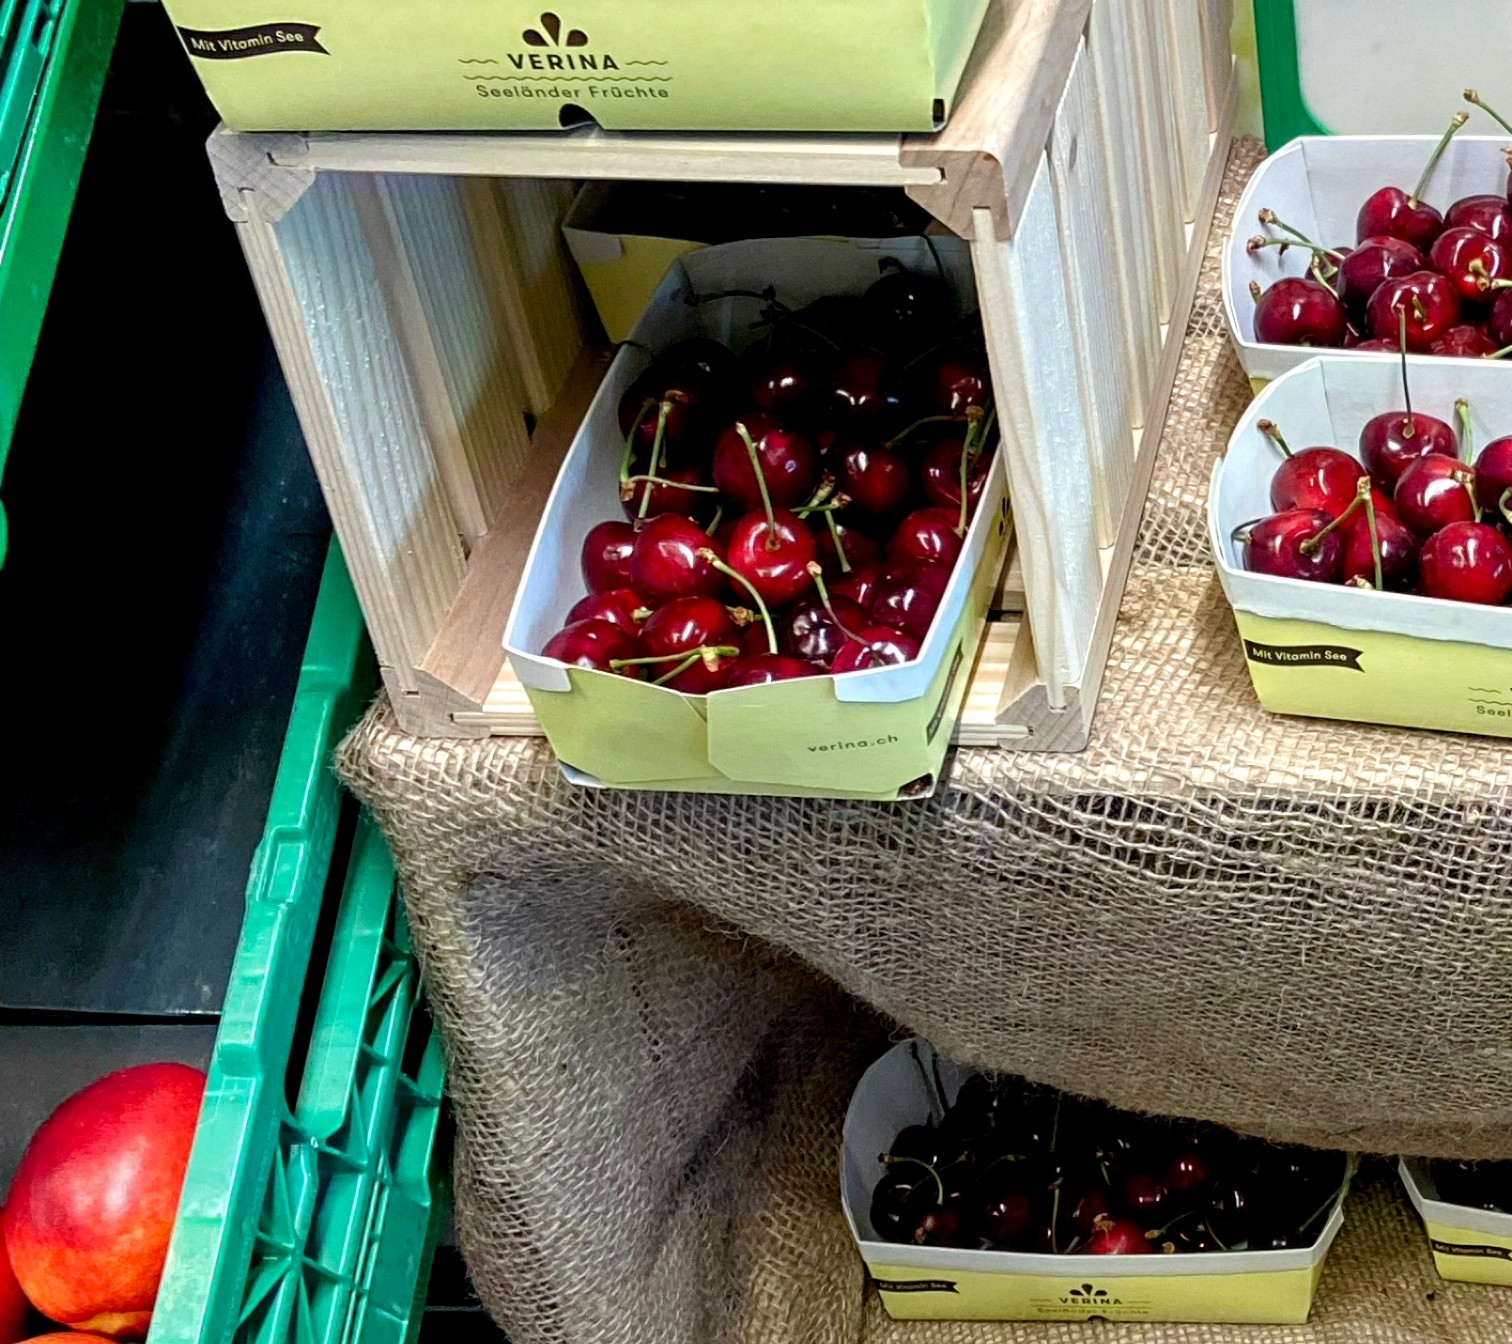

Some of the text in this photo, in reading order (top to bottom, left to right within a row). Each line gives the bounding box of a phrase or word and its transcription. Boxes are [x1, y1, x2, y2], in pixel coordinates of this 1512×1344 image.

[190, 30, 304, 52] Mit Vitamin See
[506, 53, 620, 71] VERINA
[476, 84, 669, 99] Seeländer Früchte
[1252, 647, 1347, 661] Mit Vitamin See
[807, 735, 898, 752] verina.ch
[1058, 1297, 1123, 1305] VERINA
